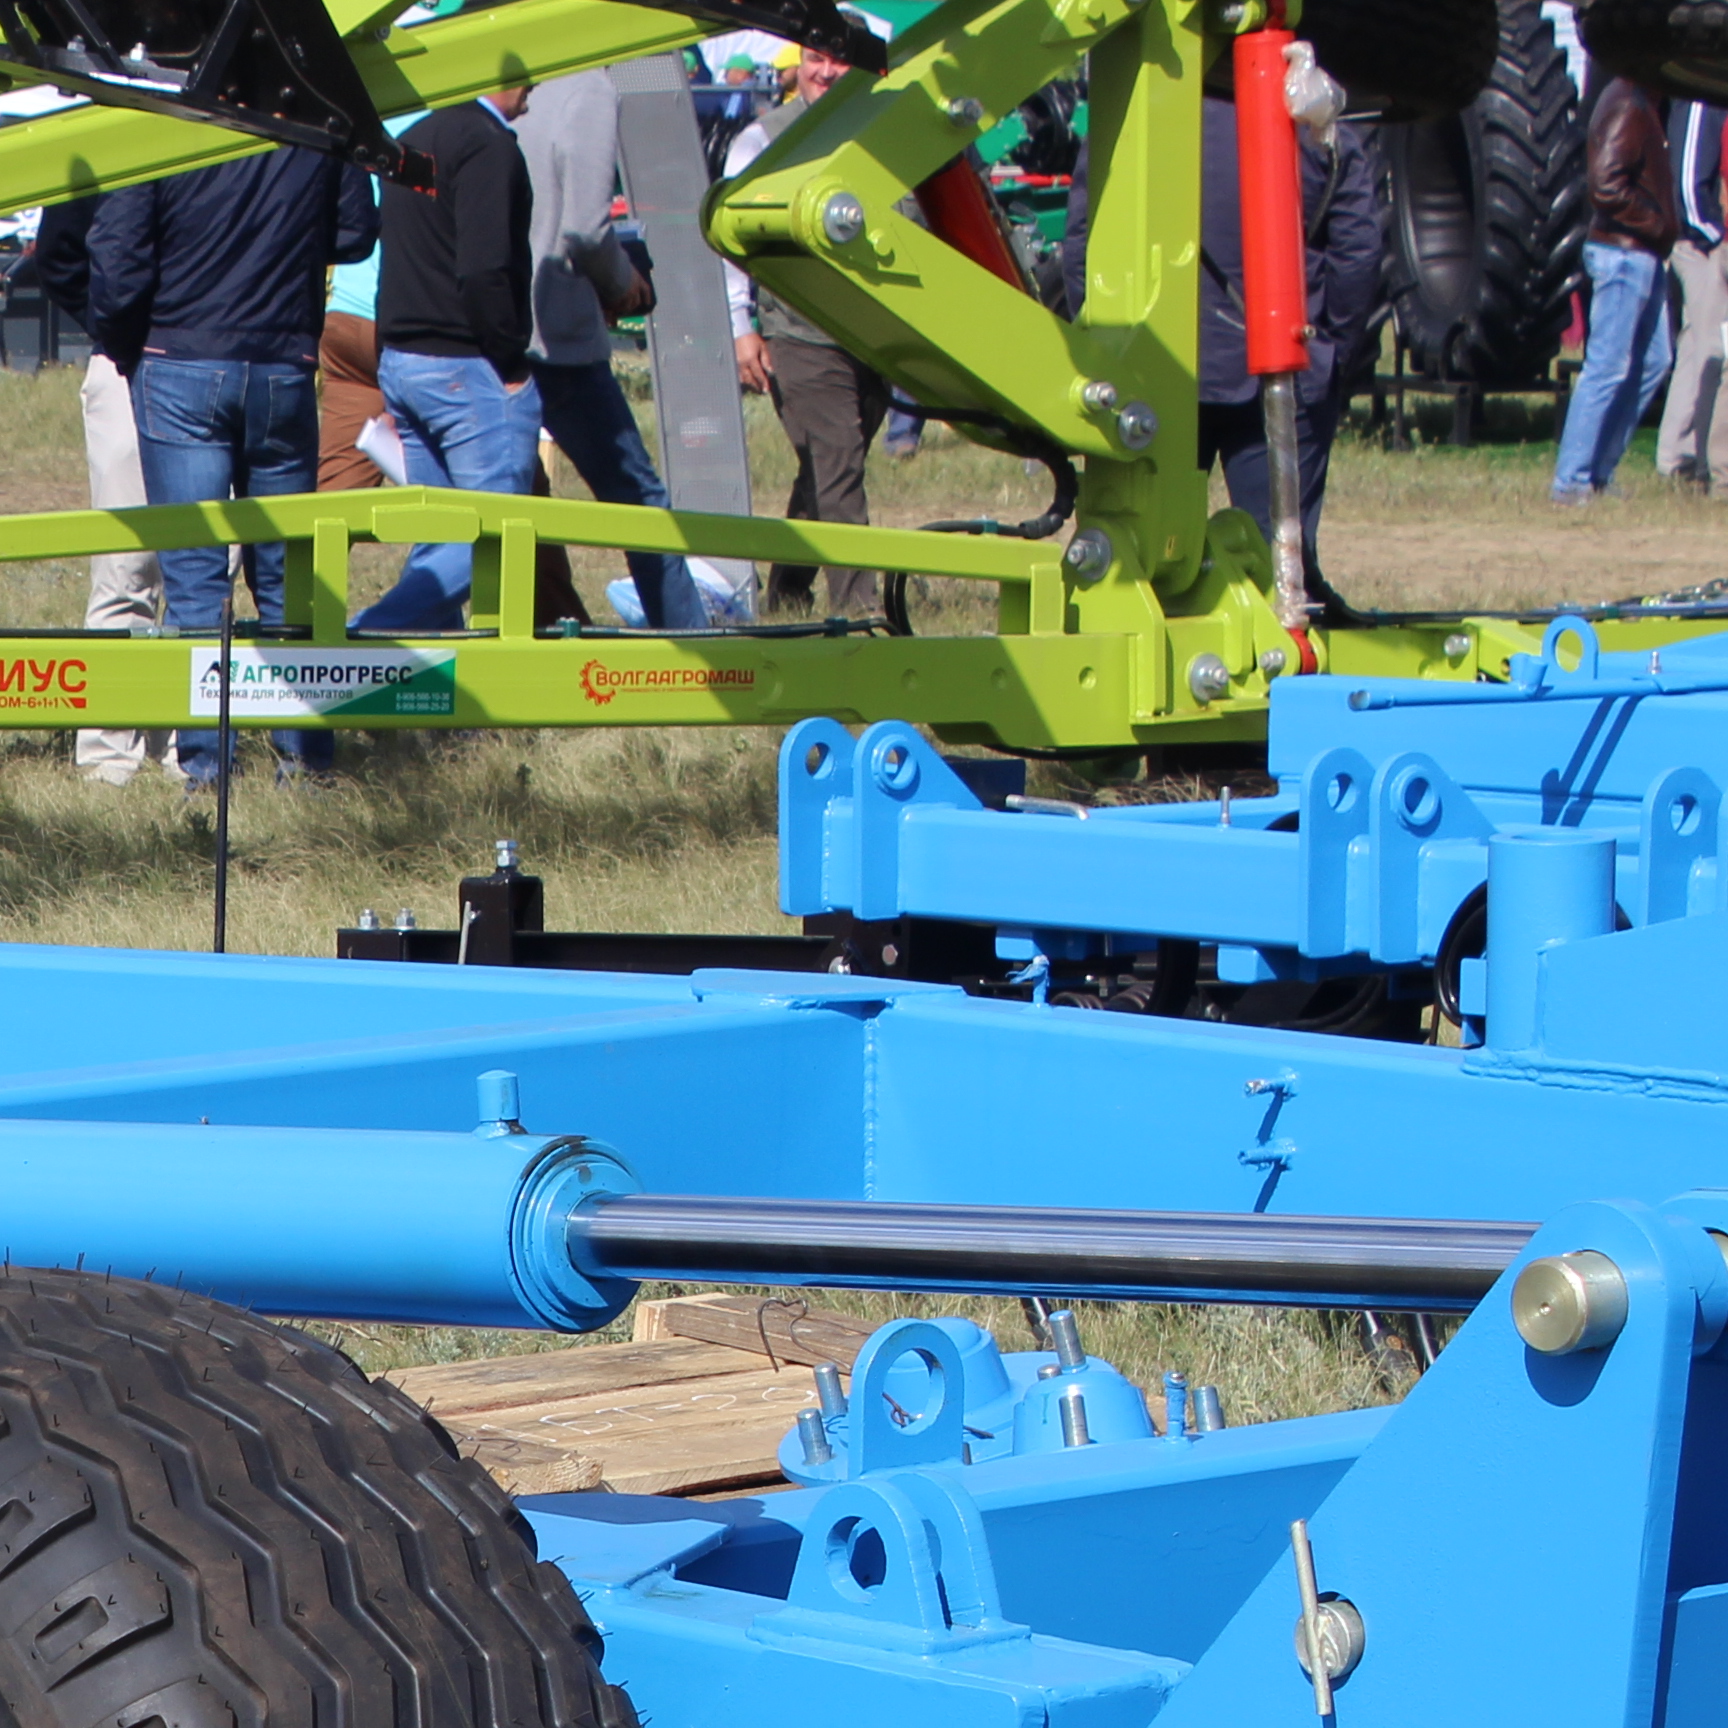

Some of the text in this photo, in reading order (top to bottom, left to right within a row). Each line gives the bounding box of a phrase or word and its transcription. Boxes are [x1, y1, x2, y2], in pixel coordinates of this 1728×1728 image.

[242, 665, 413, 685] АГРОПРОГРЕСС
[595, 669, 755, 686] ВОЛГААГРОМАШ
[251, 688, 274, 700] для
[278, 688, 354, 701] результатов
